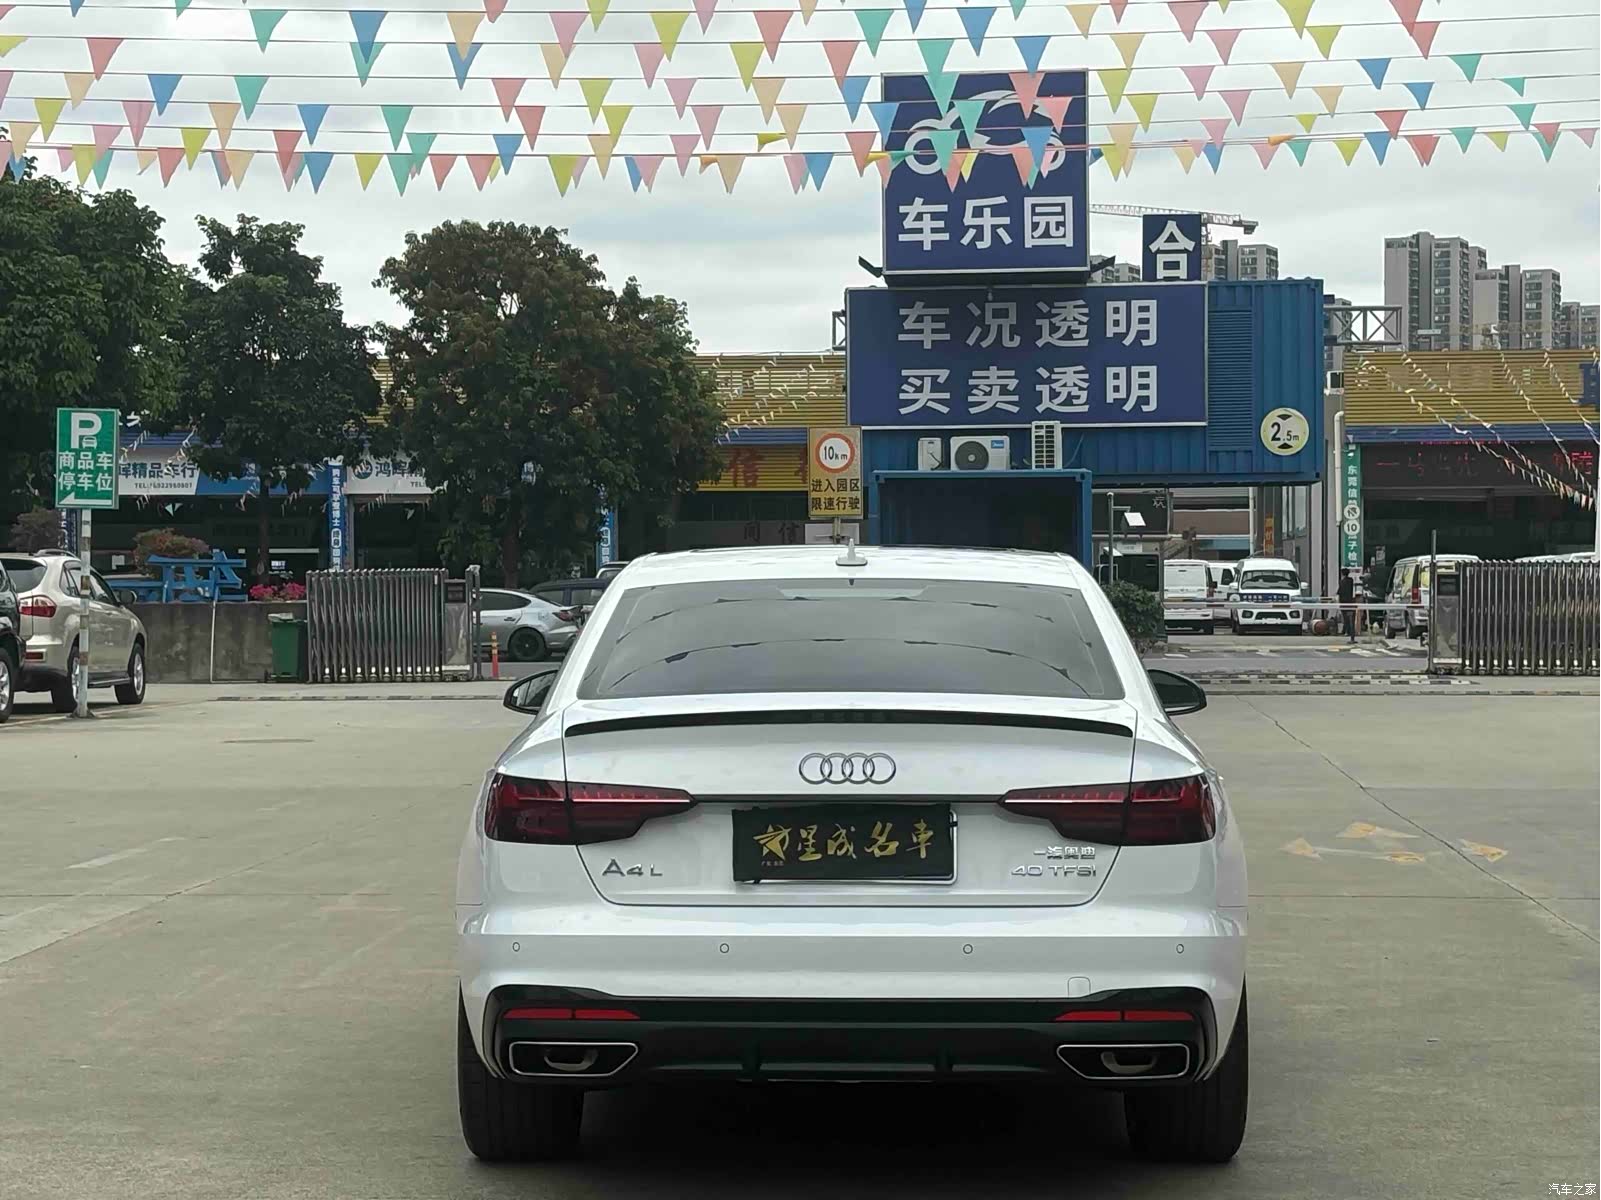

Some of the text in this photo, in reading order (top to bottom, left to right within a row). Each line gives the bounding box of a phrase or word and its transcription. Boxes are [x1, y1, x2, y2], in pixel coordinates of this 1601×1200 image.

[898, 196, 1074, 250] 车乐园
[1149, 220, 1196, 280] 合
[898, 299, 1158, 349] 车况透明
[898, 365, 1158, 415] 买卖透明
[70, 412, 102, 449] P
[59, 451, 113, 470] 商品车
[59, 471, 113, 491] 停车位
[811, 479, 860, 492] 进入园区
[811, 497, 860, 511] 限速行驶
[1011, 865, 1043, 877] 40
